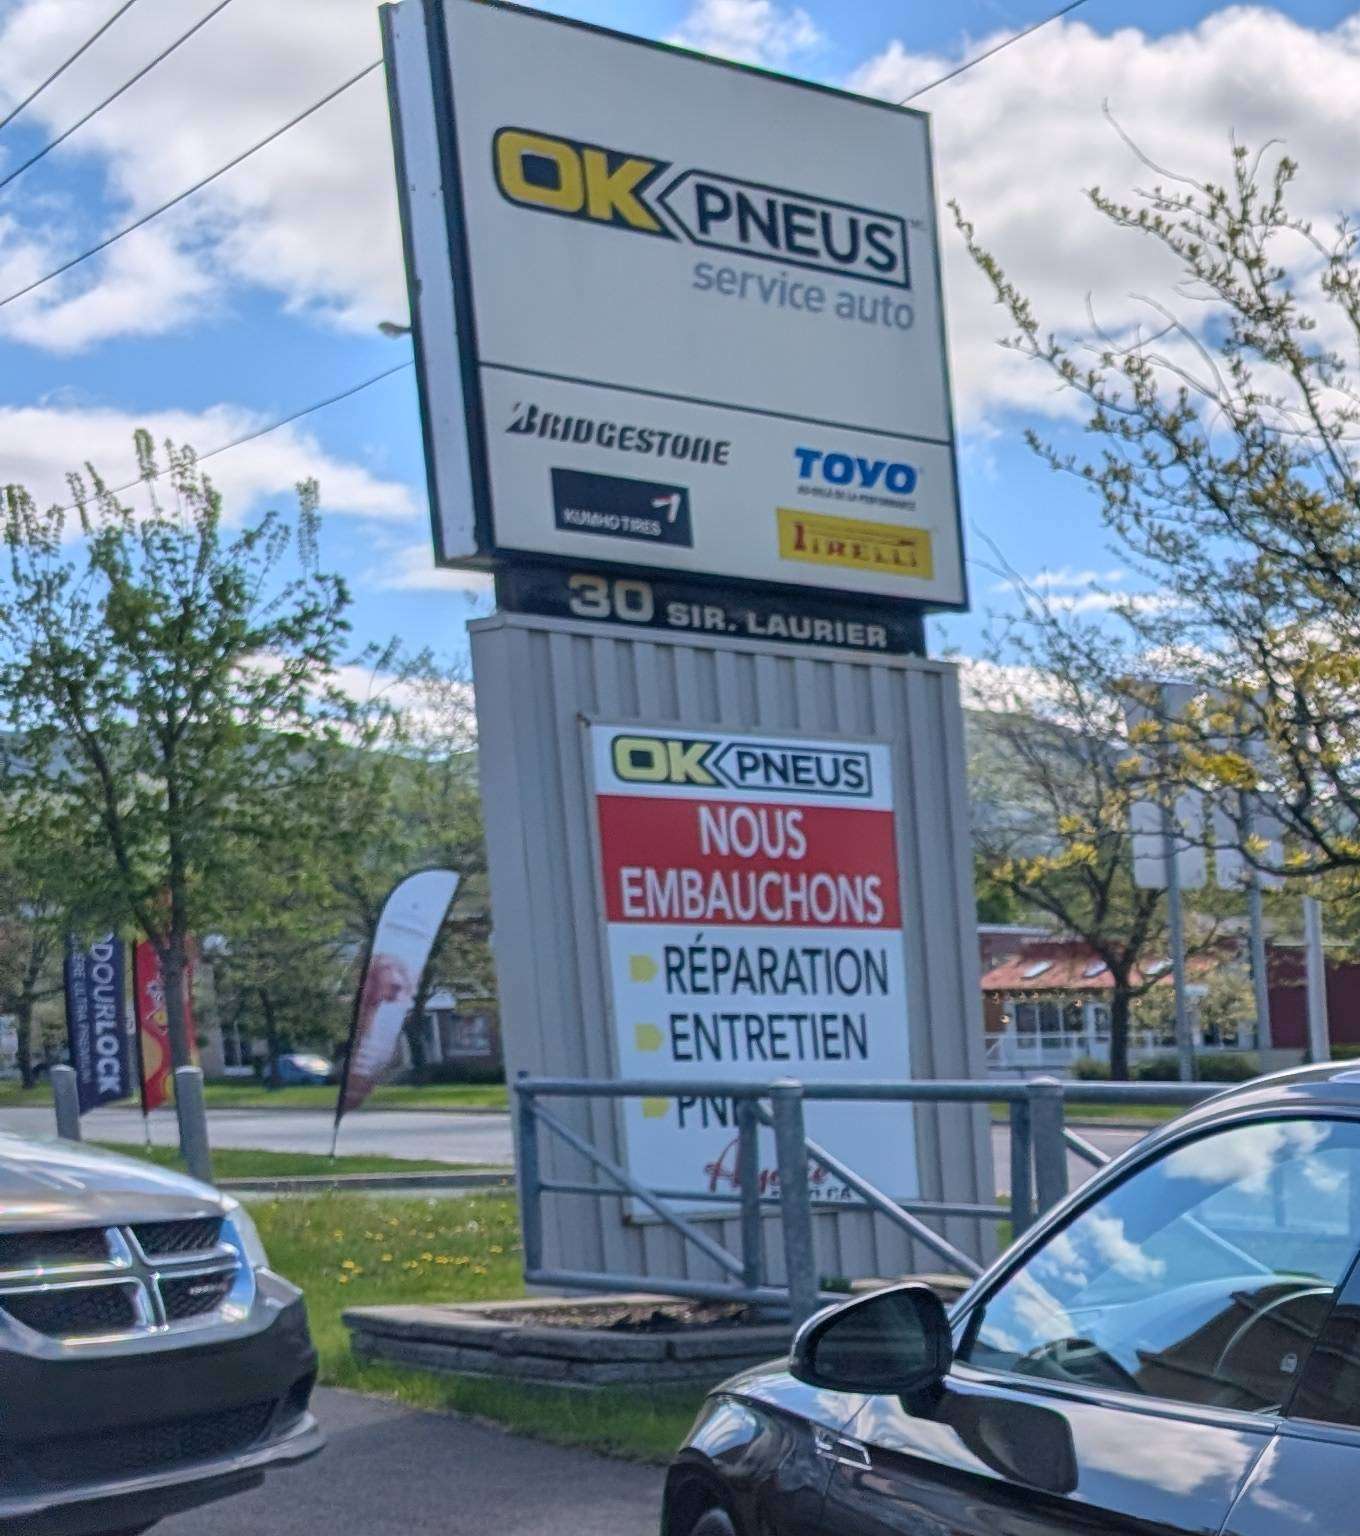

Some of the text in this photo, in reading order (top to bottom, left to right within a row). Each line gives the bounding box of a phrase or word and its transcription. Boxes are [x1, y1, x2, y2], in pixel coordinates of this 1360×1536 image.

[496, 129, 898, 274] OK PNEUS
[691, 260, 915, 331] service auto
[505, 401, 732, 466] BRIDGESTONE
[794, 446, 918, 495] TOYO
[563, 507, 663, 537] KUMHO TIRES
[567, 573, 888, 648] 30 SIR. LAURIER
[613, 736, 867, 791] OK PNEUS
[699, 804, 807, 860] NOUS
[619, 867, 885, 924] EMBAUCHONS
[663, 932, 889, 997] RÉPARATION
[90, 932, 121, 1094] DOURLOCK
[670, 1013, 869, 1062] ENTRETIEN
